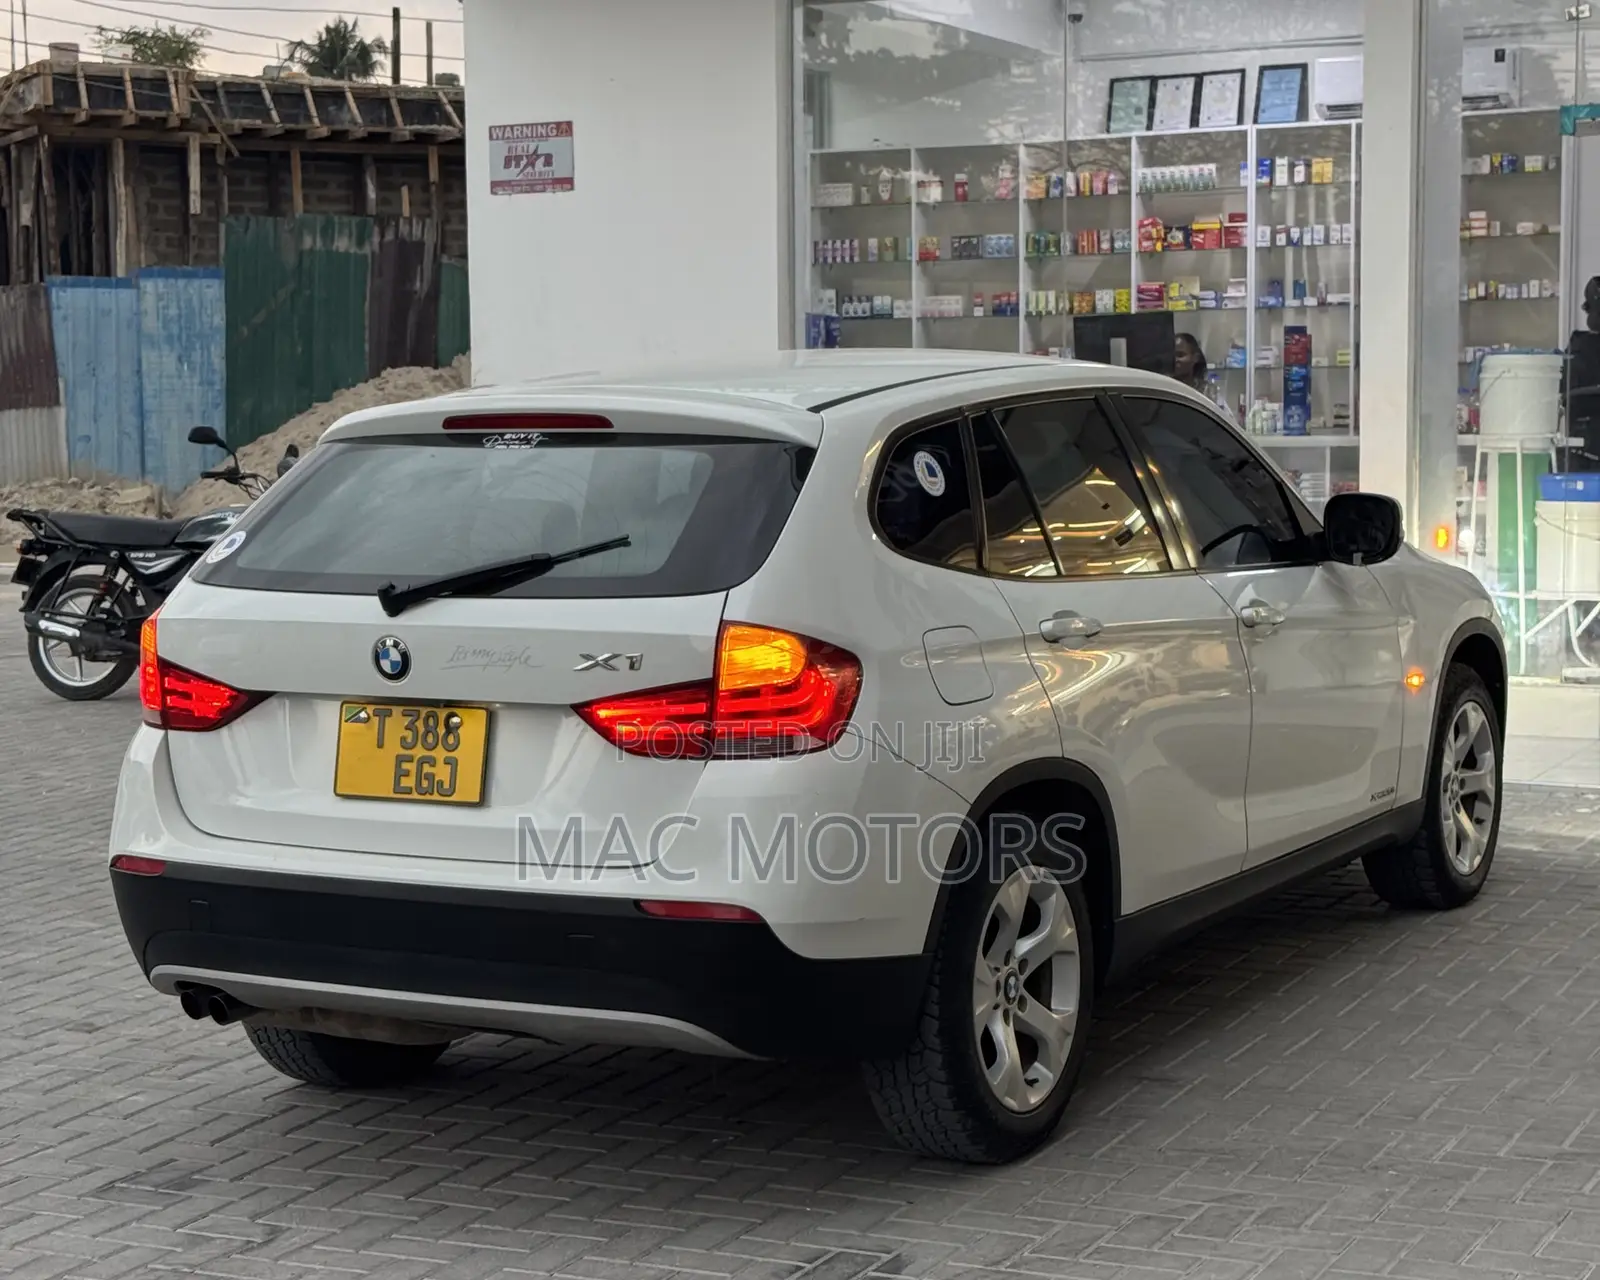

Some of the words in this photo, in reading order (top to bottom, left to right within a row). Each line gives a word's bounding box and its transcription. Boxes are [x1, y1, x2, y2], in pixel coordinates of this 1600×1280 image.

[491, 124, 557, 139] WARNING
[573, 652, 644, 672] X1
[372, 708, 393, 748] T
[400, 709, 461, 752] 388
[393, 754, 459, 797] EGJ
